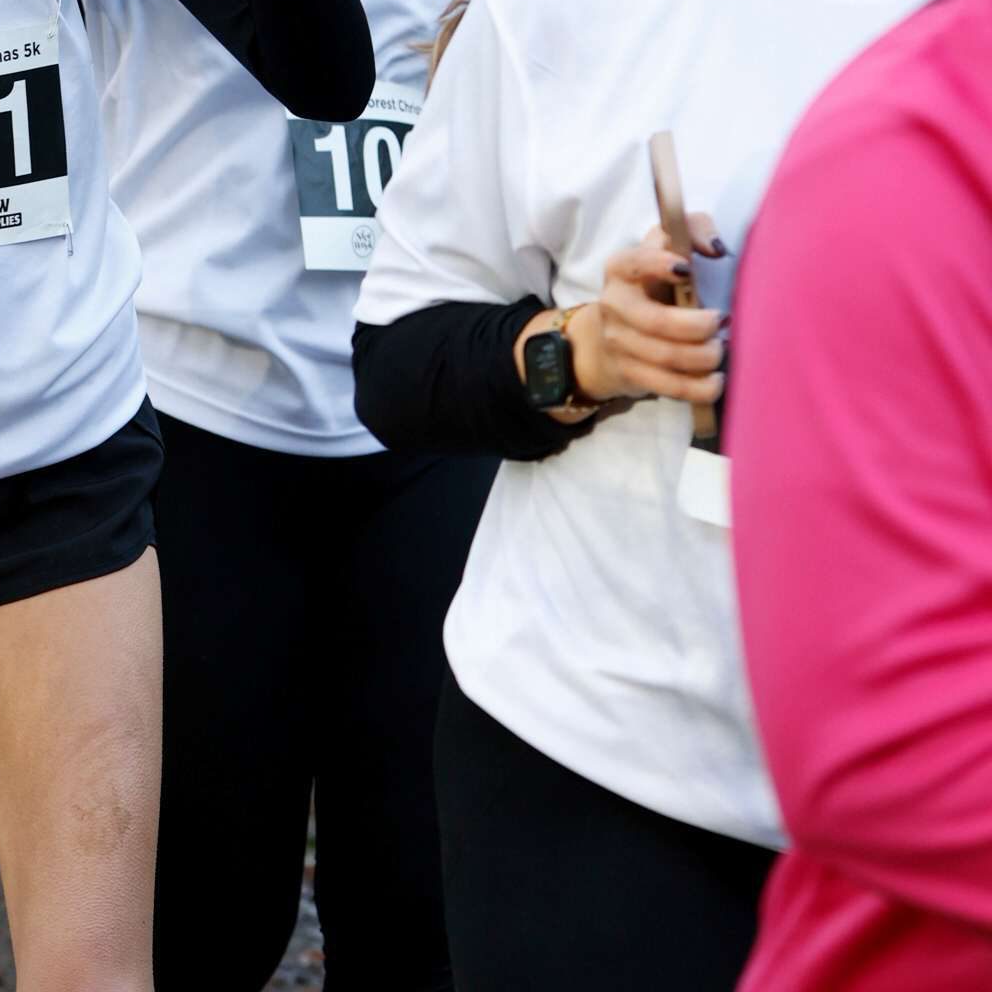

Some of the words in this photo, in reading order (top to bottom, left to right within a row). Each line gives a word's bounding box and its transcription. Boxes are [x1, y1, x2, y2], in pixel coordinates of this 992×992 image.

[24, 41, 41, 58] 5k
[367, 97, 396, 110] orest
[314, 124, 414, 211] 10
